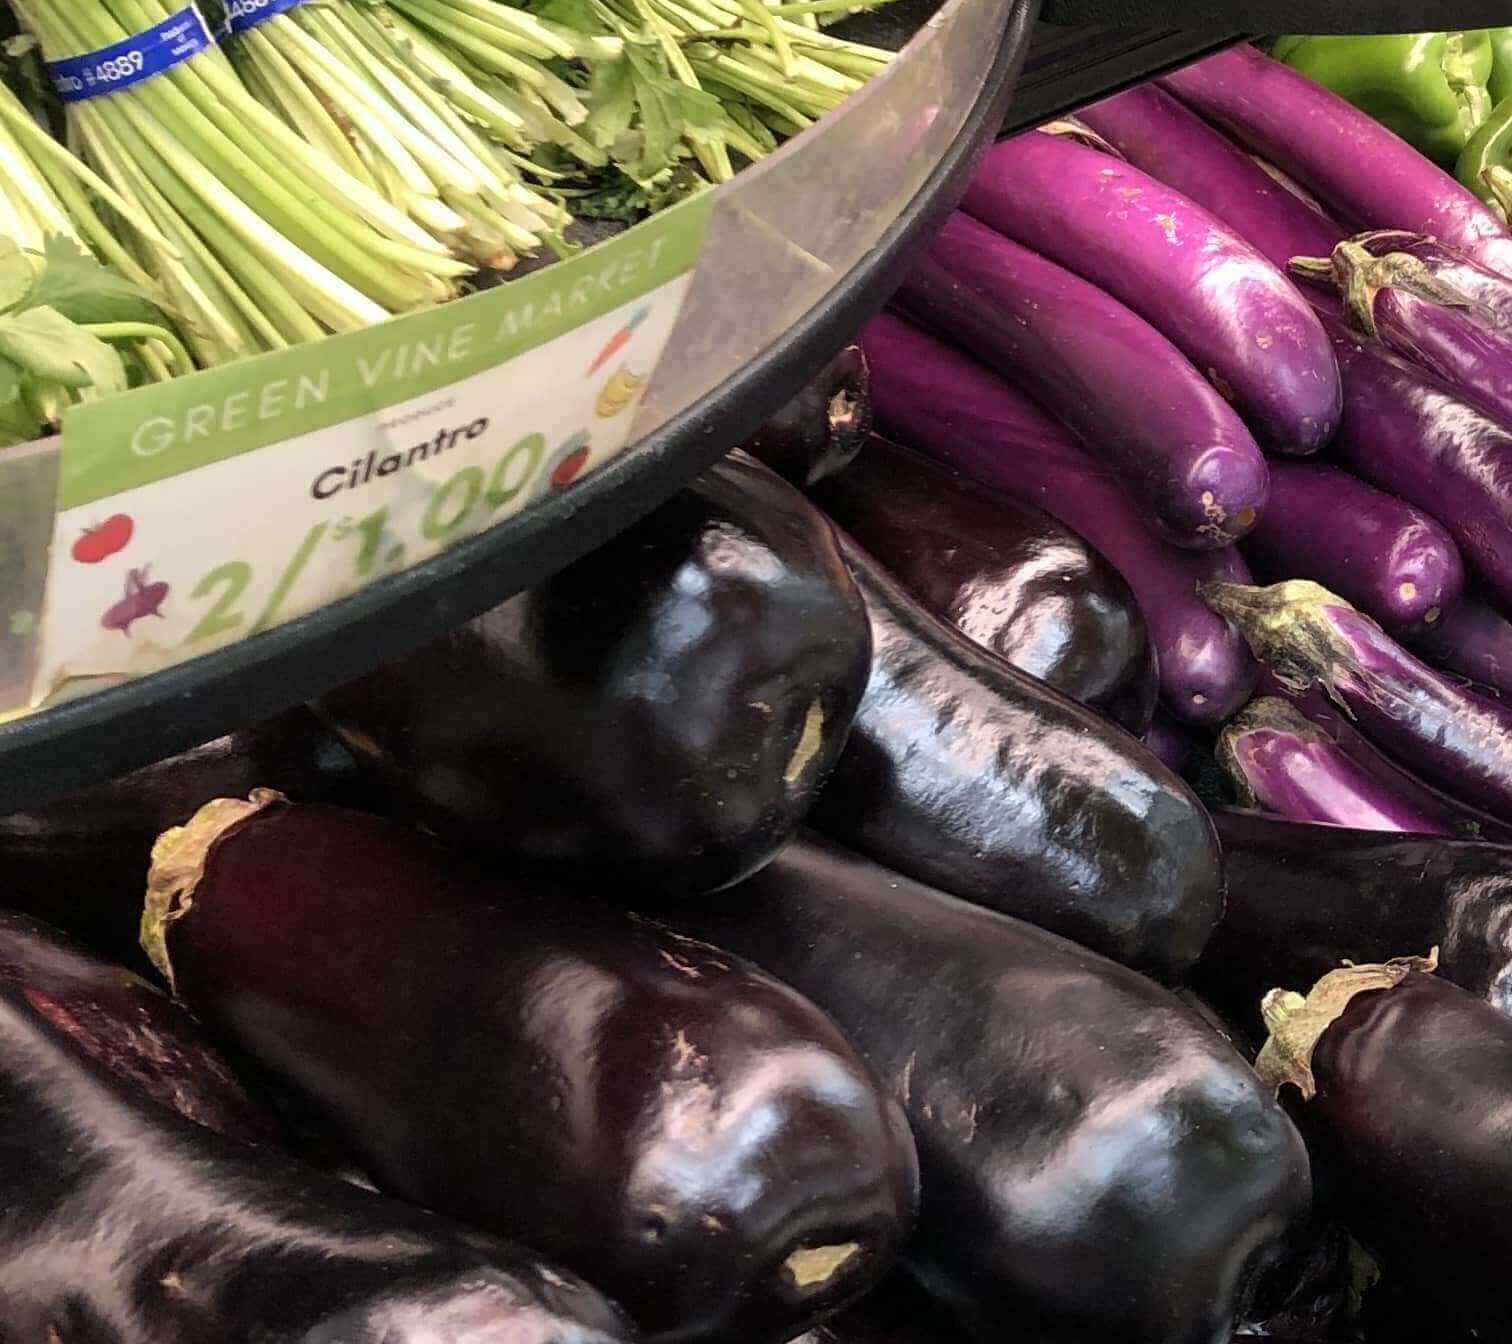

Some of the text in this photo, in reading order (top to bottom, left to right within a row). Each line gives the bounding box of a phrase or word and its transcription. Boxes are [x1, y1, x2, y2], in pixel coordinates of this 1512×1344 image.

[131, 238, 668, 456] GREEN VINE MARKET
[311, 416, 490, 500] Cilantro
